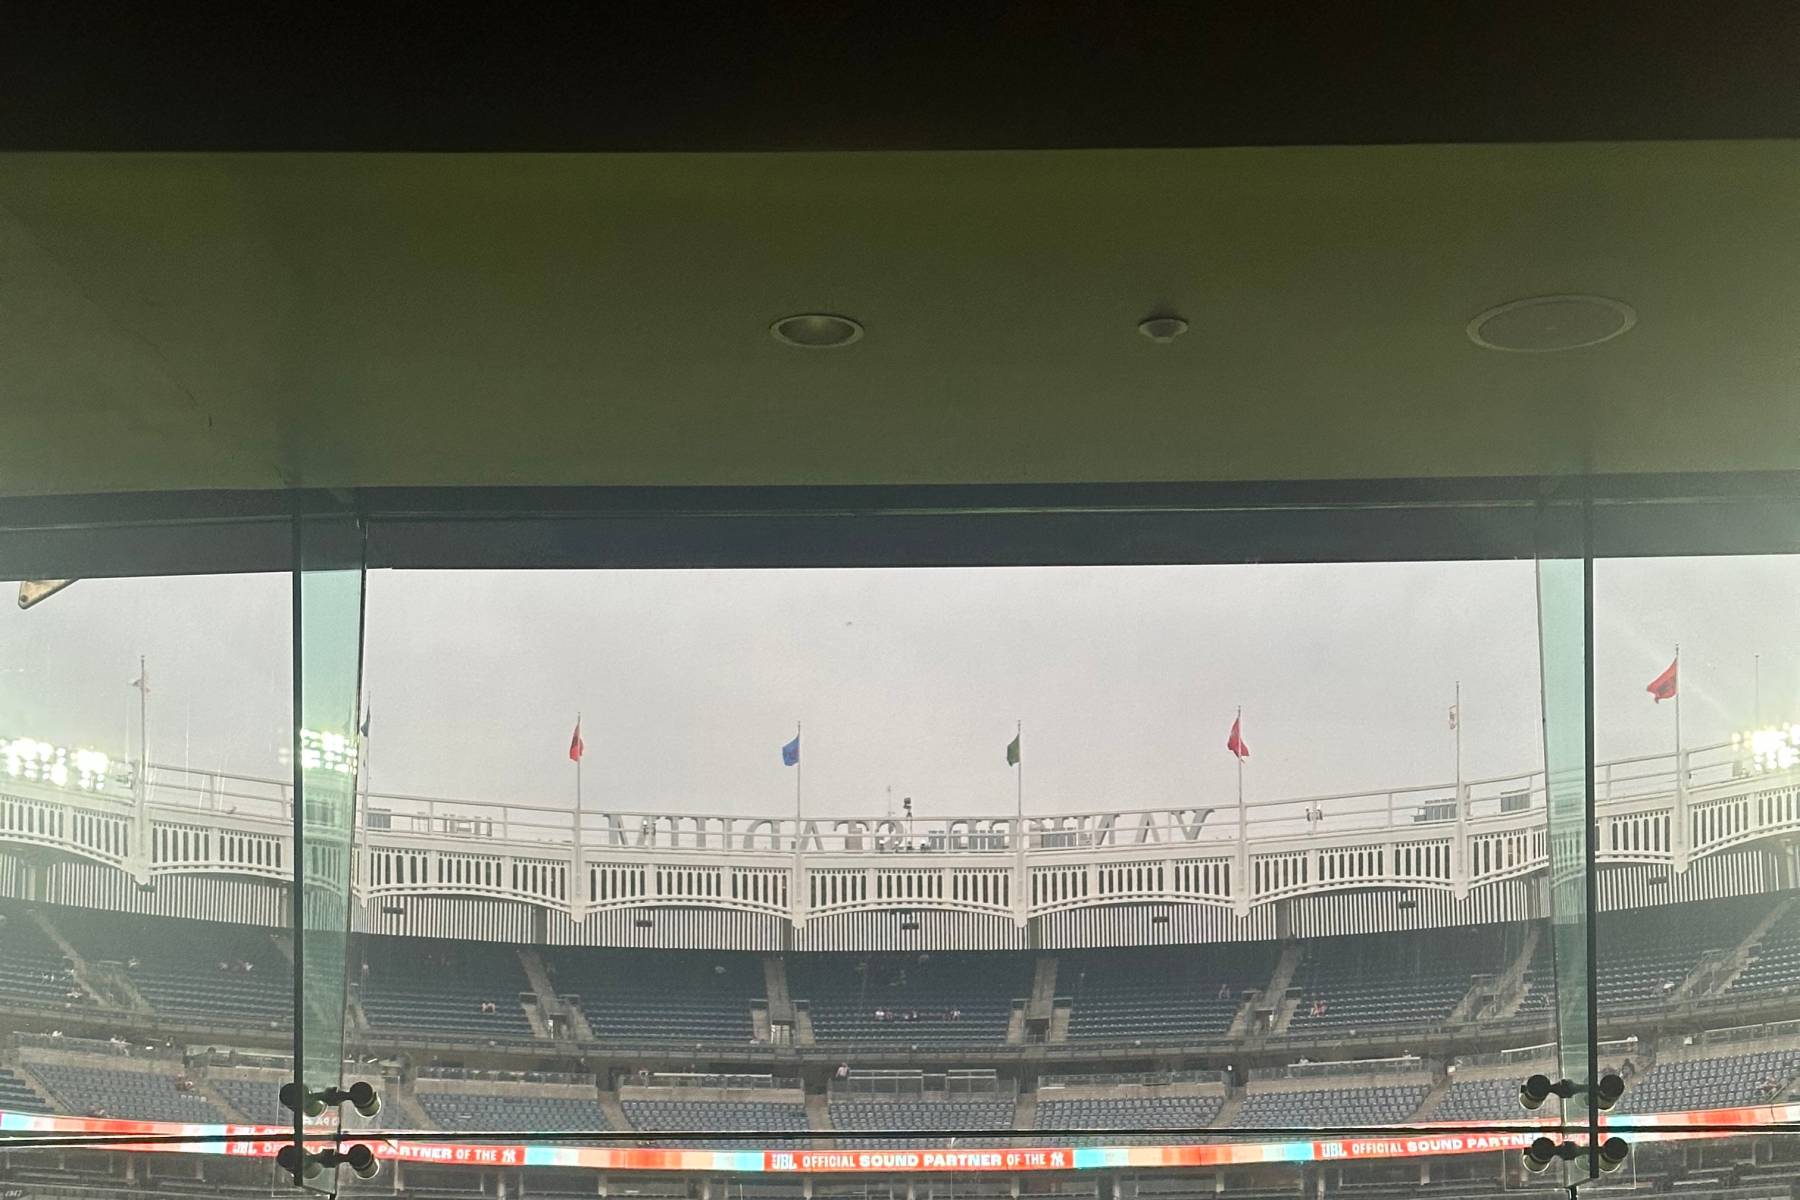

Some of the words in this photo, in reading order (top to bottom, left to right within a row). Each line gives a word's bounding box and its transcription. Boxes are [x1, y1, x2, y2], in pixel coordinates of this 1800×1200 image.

[377, 1143, 452, 1160] PARTNER
[456, 1149, 469, 1160] OF
[475, 1149, 497, 1161] THE
[1320, 1141, 1347, 1158] JBL
[1352, 1142, 1403, 1154] OFFICIAL
[1406, 1138, 1463, 1152] SOUND
[1467, 1133, 1540, 1148] PARTNE
[771, 1153, 798, 1170] JBL
[802, 1154, 856, 1168] OFFICIAL
[859, 1154, 919, 1167] SOUND
[923, 1153, 1002, 1167] PARTNER
[1007, 1153, 1021, 1166] OF
[1024, 1153, 1046, 1166] THE
